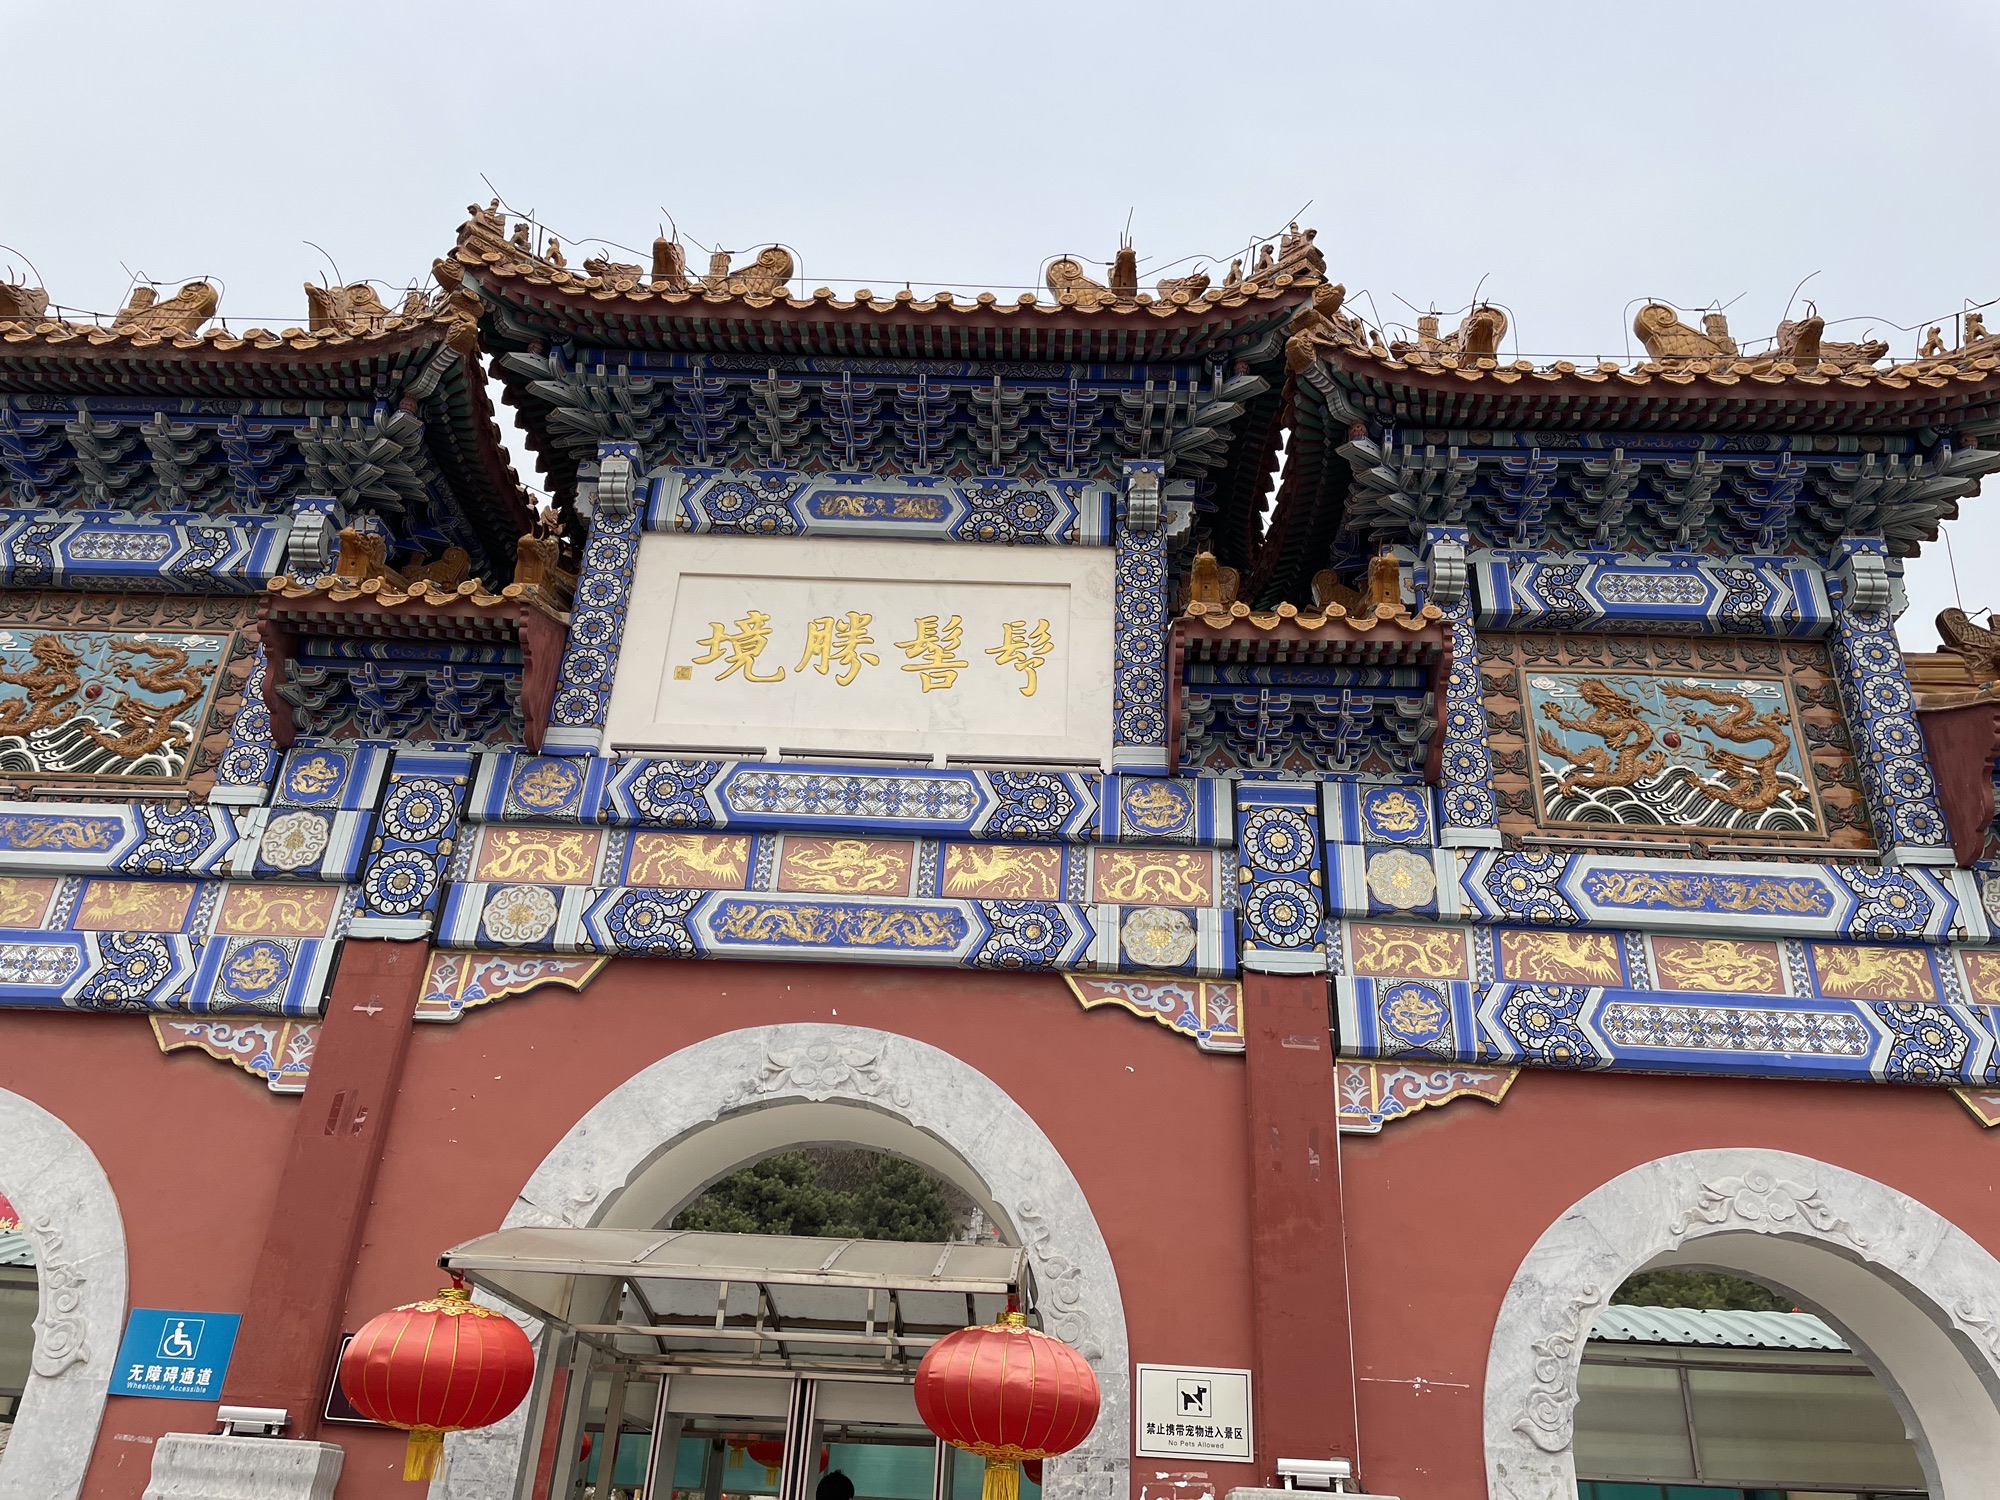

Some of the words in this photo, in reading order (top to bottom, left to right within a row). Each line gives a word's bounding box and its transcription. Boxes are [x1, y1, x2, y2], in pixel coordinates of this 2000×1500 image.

[127, 1363, 213, 1386] 无障碍通道
[126, 1381, 166, 1391] Wheelchair
[169, 1384, 207, 1394] Accessible
[1146, 1422, 1243, 1440] 禁止携带宠物进入景区
[1168, 1439, 1178, 1447] No
[1197, 1441, 1225, 1449] Allowed
